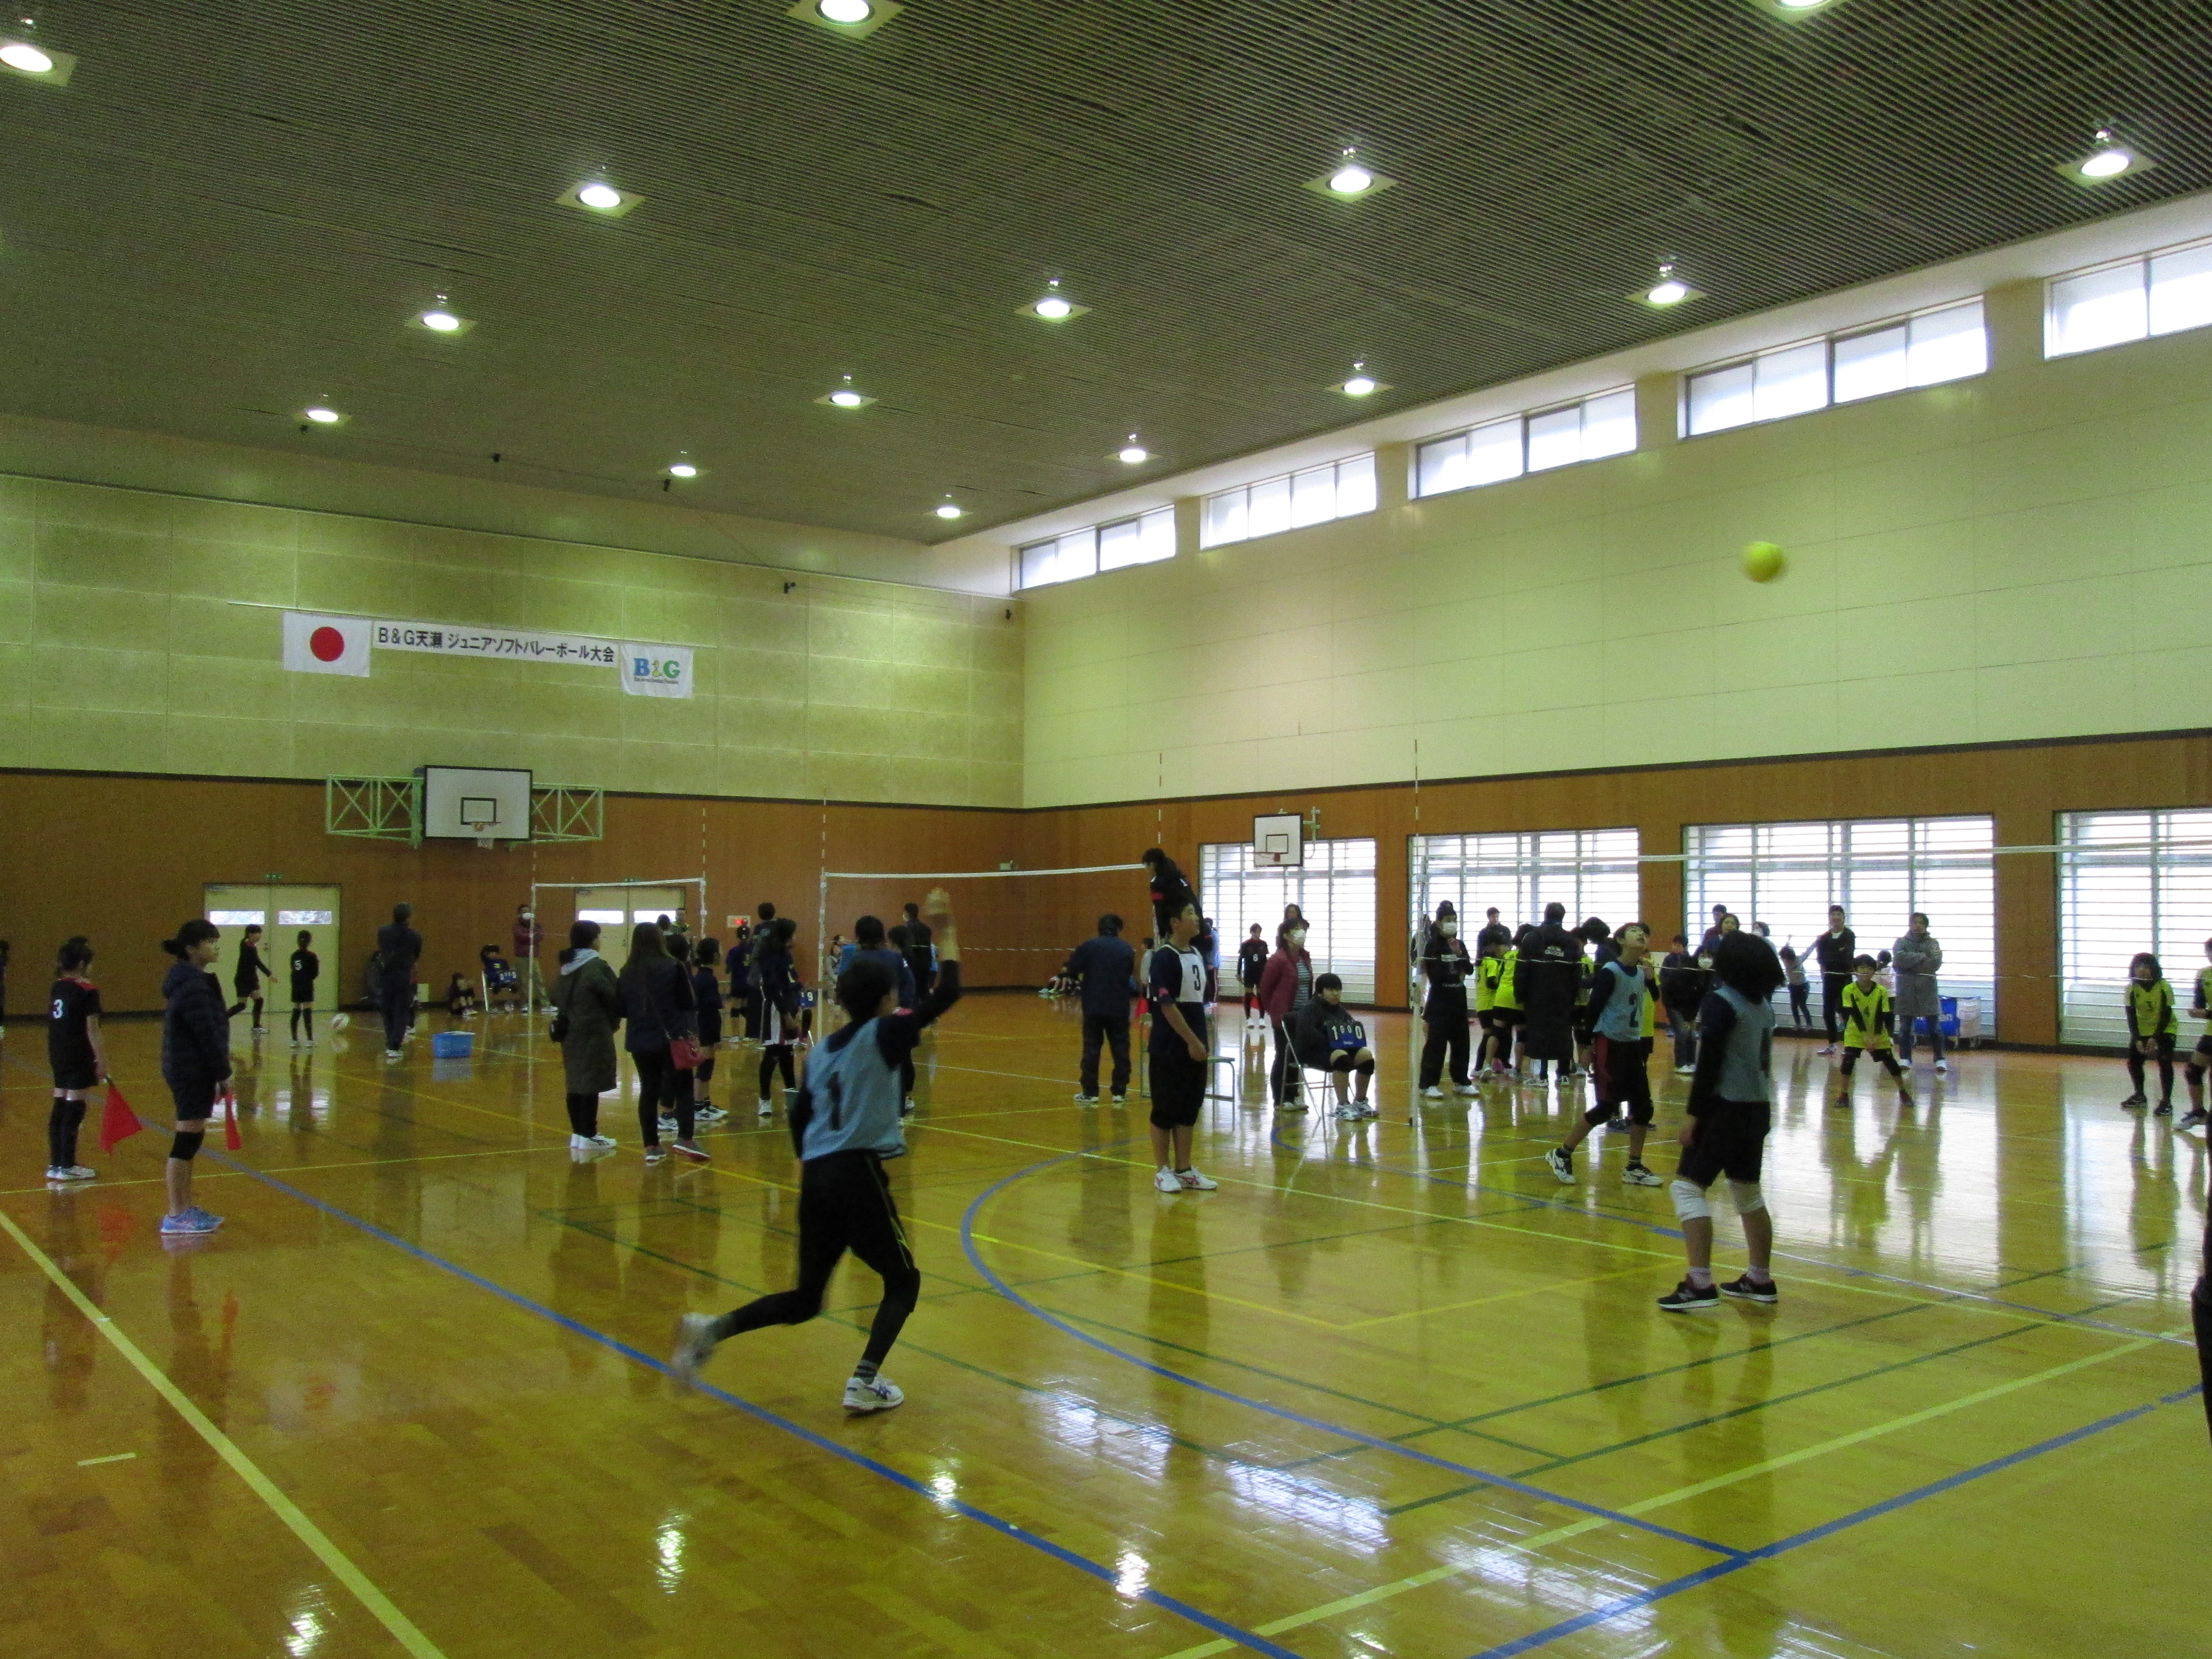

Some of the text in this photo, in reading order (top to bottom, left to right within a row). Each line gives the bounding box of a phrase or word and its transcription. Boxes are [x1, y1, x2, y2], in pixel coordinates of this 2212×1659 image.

[448, 633, 614, 662] ジュニアソフトバレーボール大会
[1192, 965, 1201, 991] 3
[53, 999, 63, 1019] 3
[1629, 993, 1638, 1027] 2
[1332, 1025, 1338, 1040] 1
[1355, 1025, 1363, 1039] 0
[827, 1070, 842, 1131] 1
